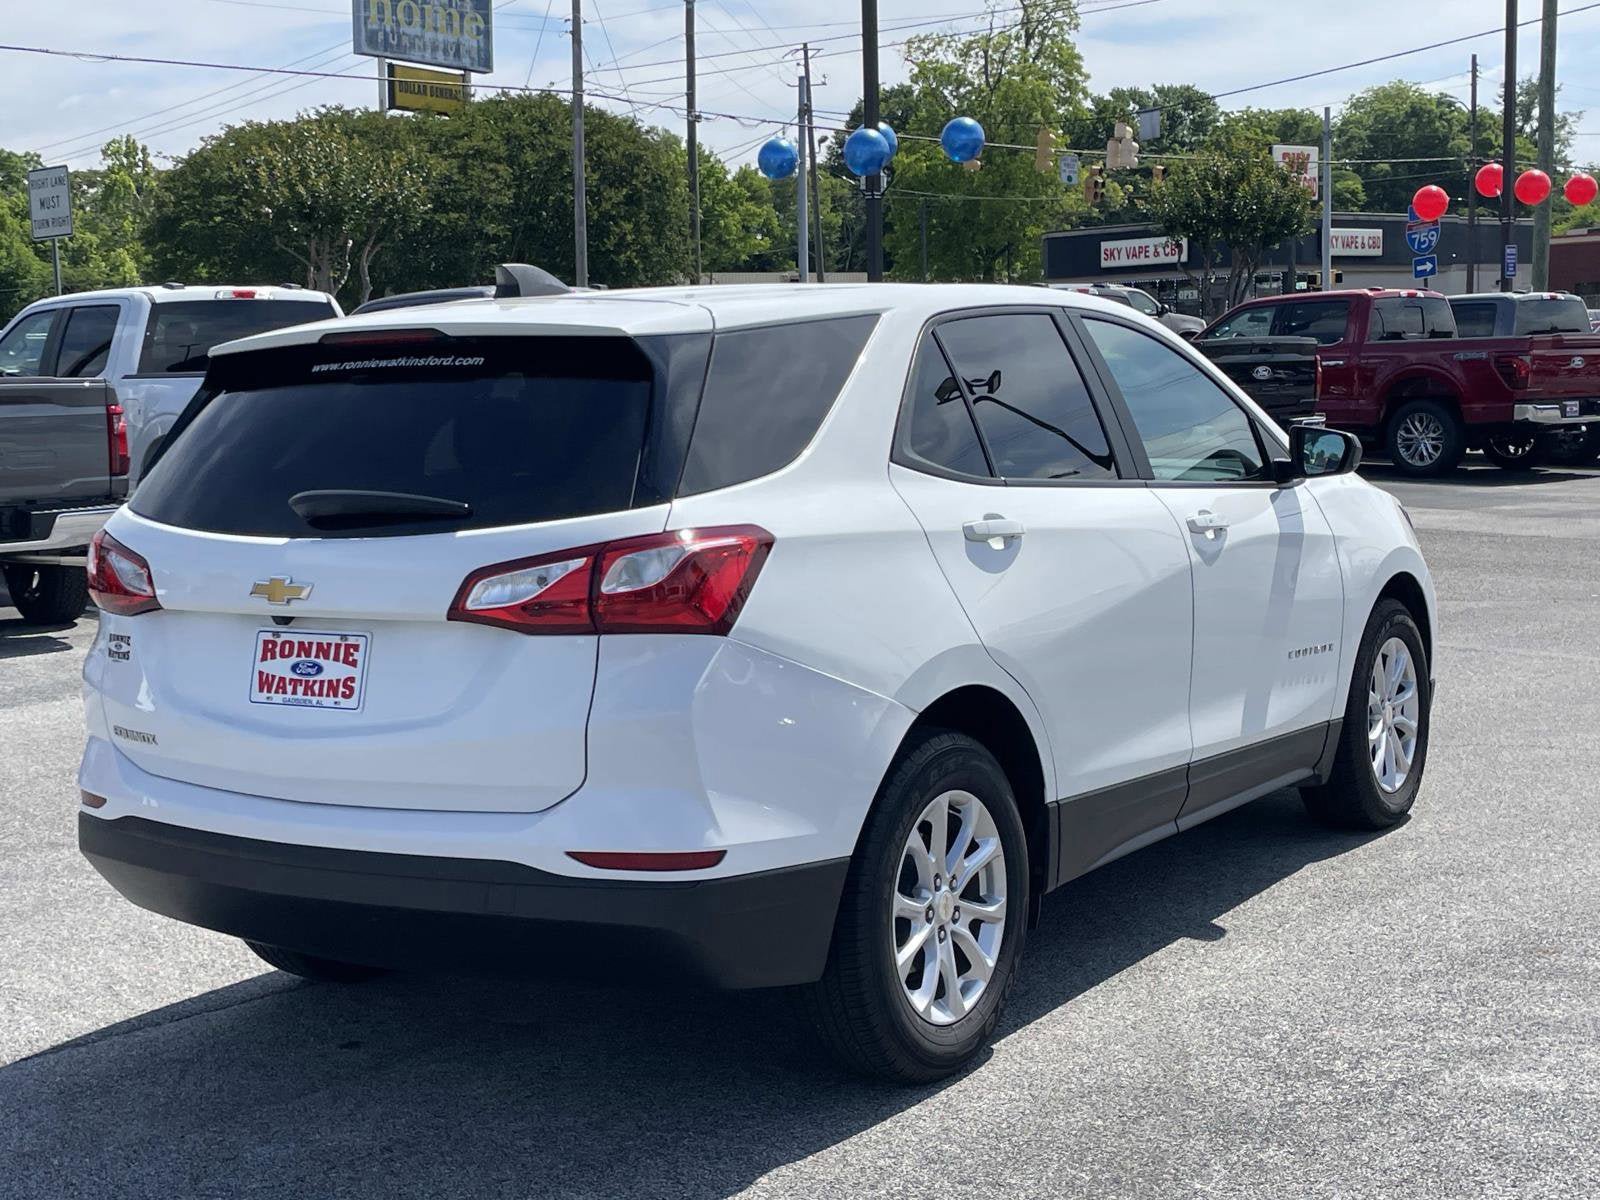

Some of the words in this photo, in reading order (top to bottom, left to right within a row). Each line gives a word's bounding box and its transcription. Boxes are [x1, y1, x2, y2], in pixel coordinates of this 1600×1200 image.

[399, 81, 428, 97] DOLLAR
[39, 195, 60, 210] MUST
[1330, 235, 1340, 249] KY
[1341, 235, 1359, 249] VAPE
[1360, 236, 1366, 249] &
[1367, 236, 1381, 249] CBD
[1411, 230, 1438, 250] 759
[1103, 247, 1122, 261] SKY
[1125, 245, 1150, 260] VAPE
[1153, 244, 1160, 258] &
[311, 356, 485, 373] www.ronniewatkinsford.com
[260, 639, 360, 669] RONNIE
[258, 670, 356, 700] WATKINS
